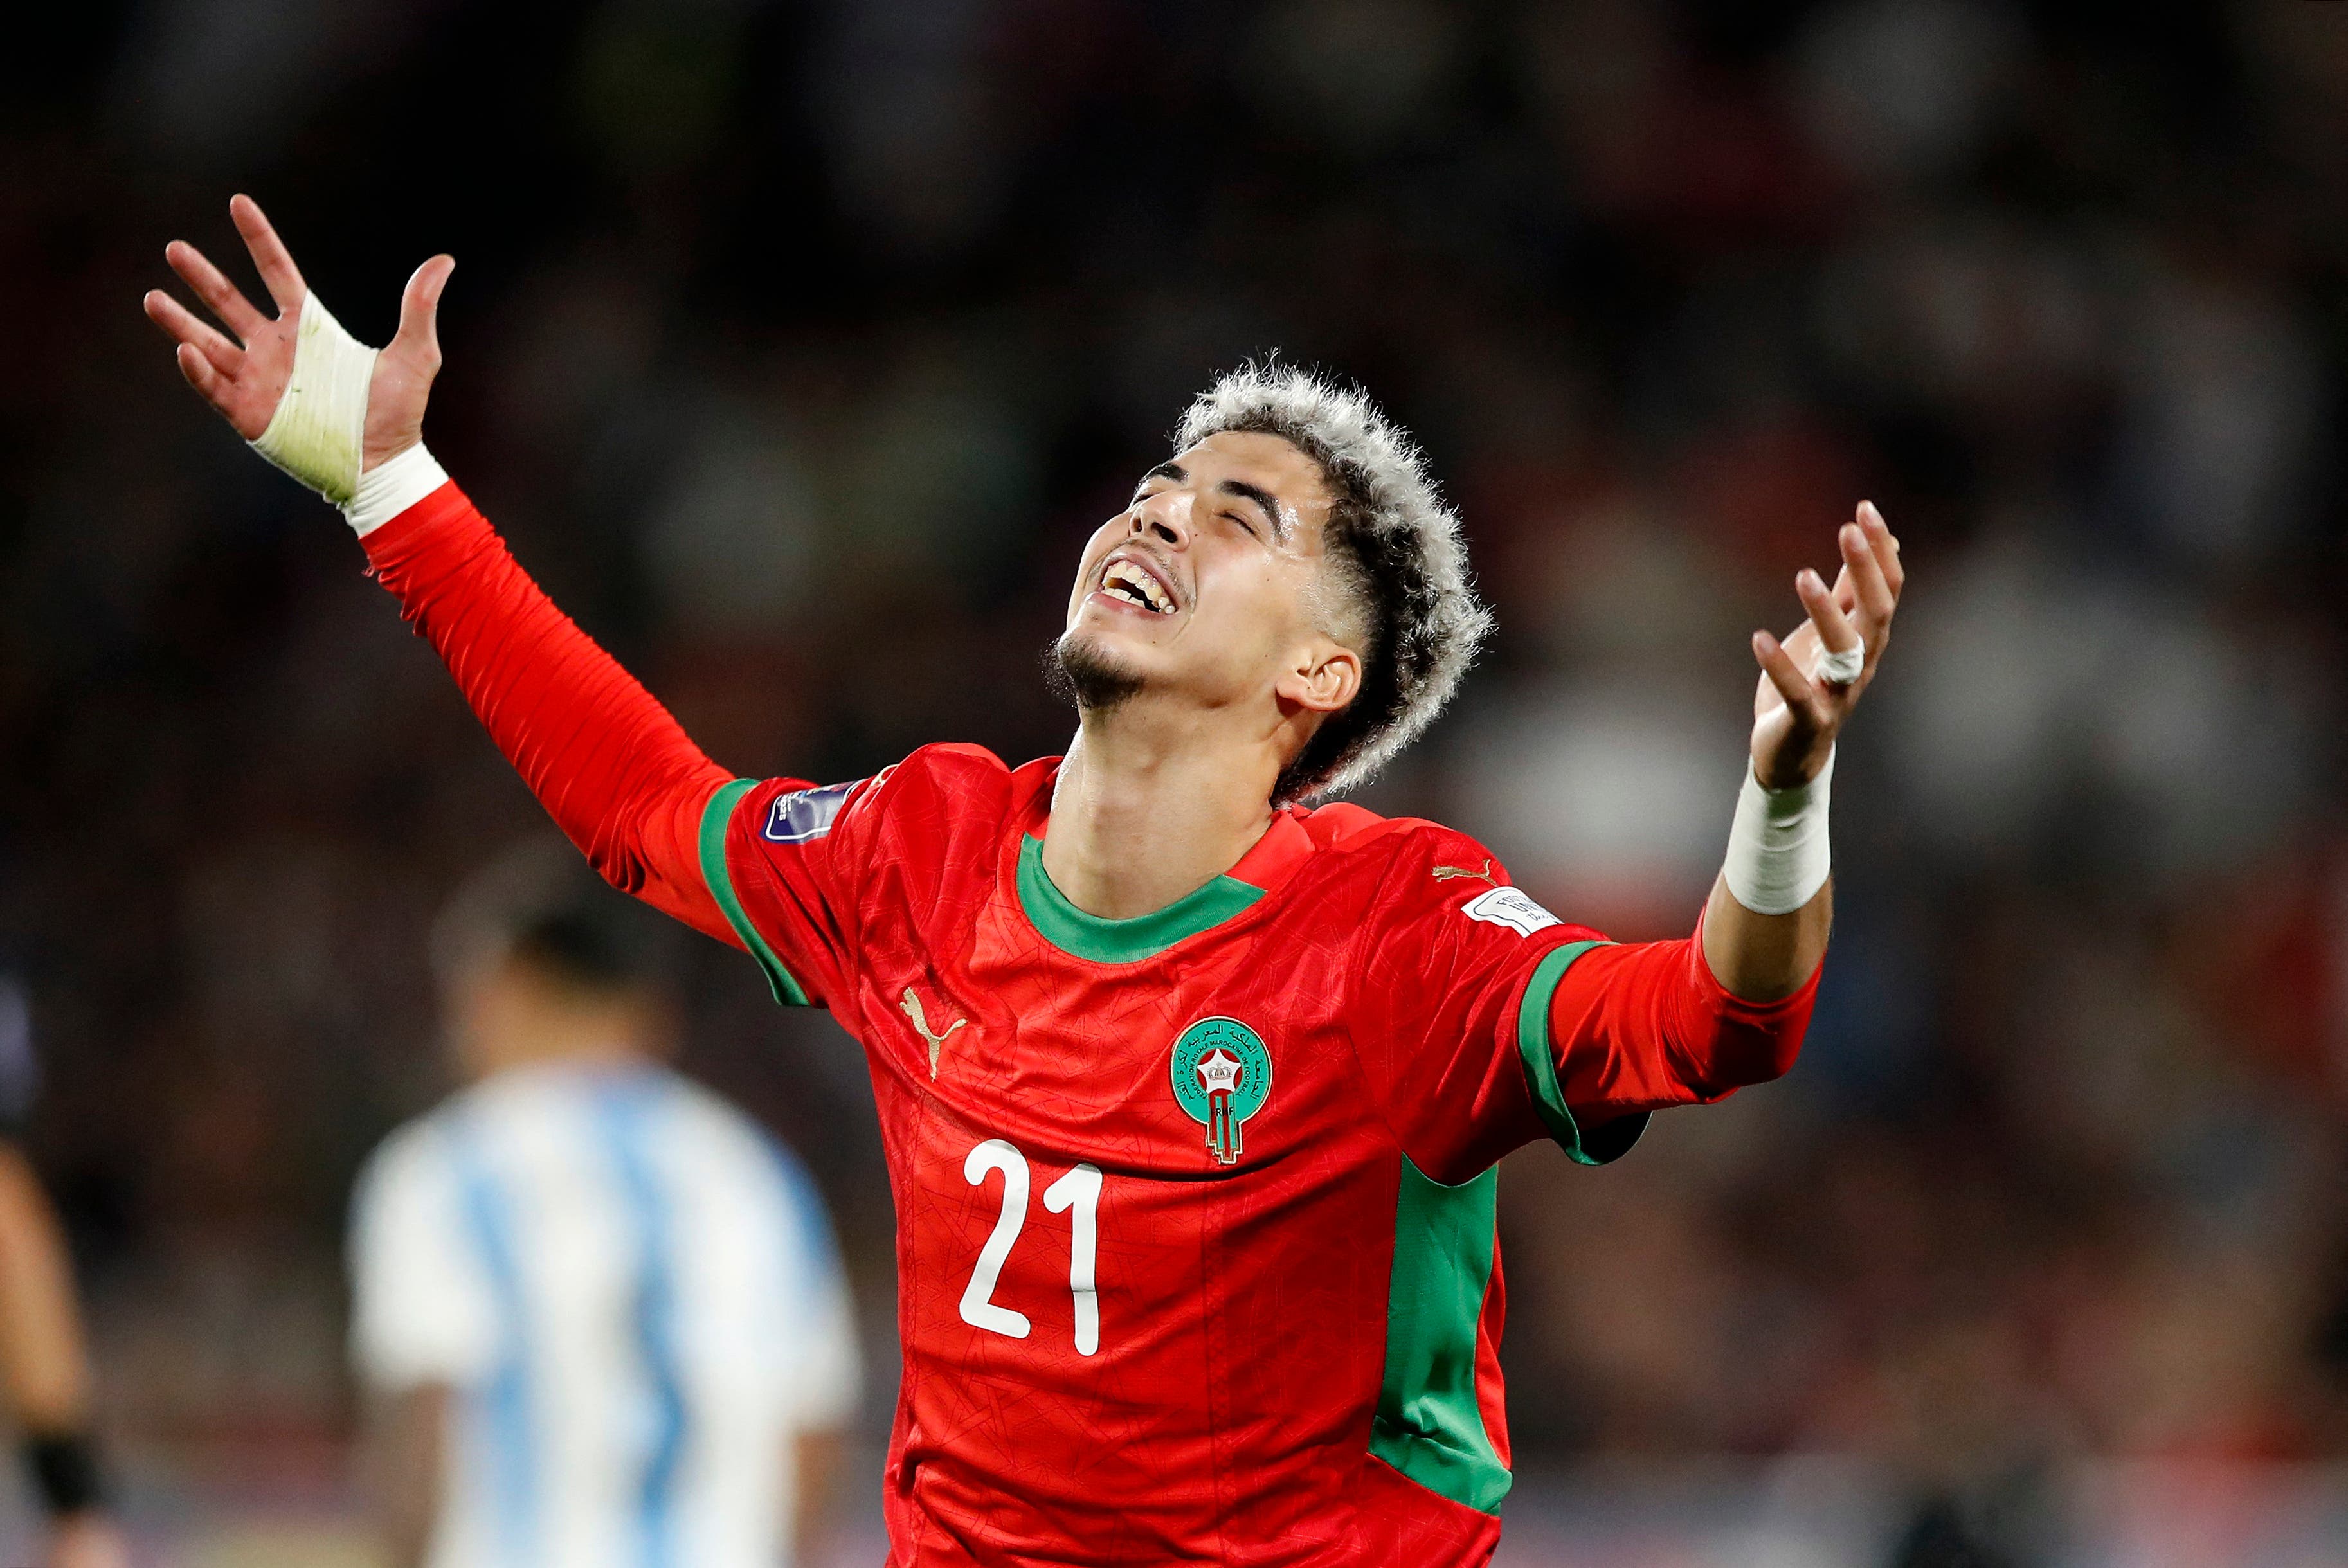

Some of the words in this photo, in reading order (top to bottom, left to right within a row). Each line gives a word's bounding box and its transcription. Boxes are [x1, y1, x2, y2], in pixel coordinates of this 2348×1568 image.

[1191, 1043, 1209, 1063] ROYALE
[1209, 1040, 1243, 1055] MAROCAINE
[1242, 1056, 1249, 1065] DE
[1235, 1066, 1250, 1097] FOOTBALL
[959, 1139, 1103, 1356] 21
